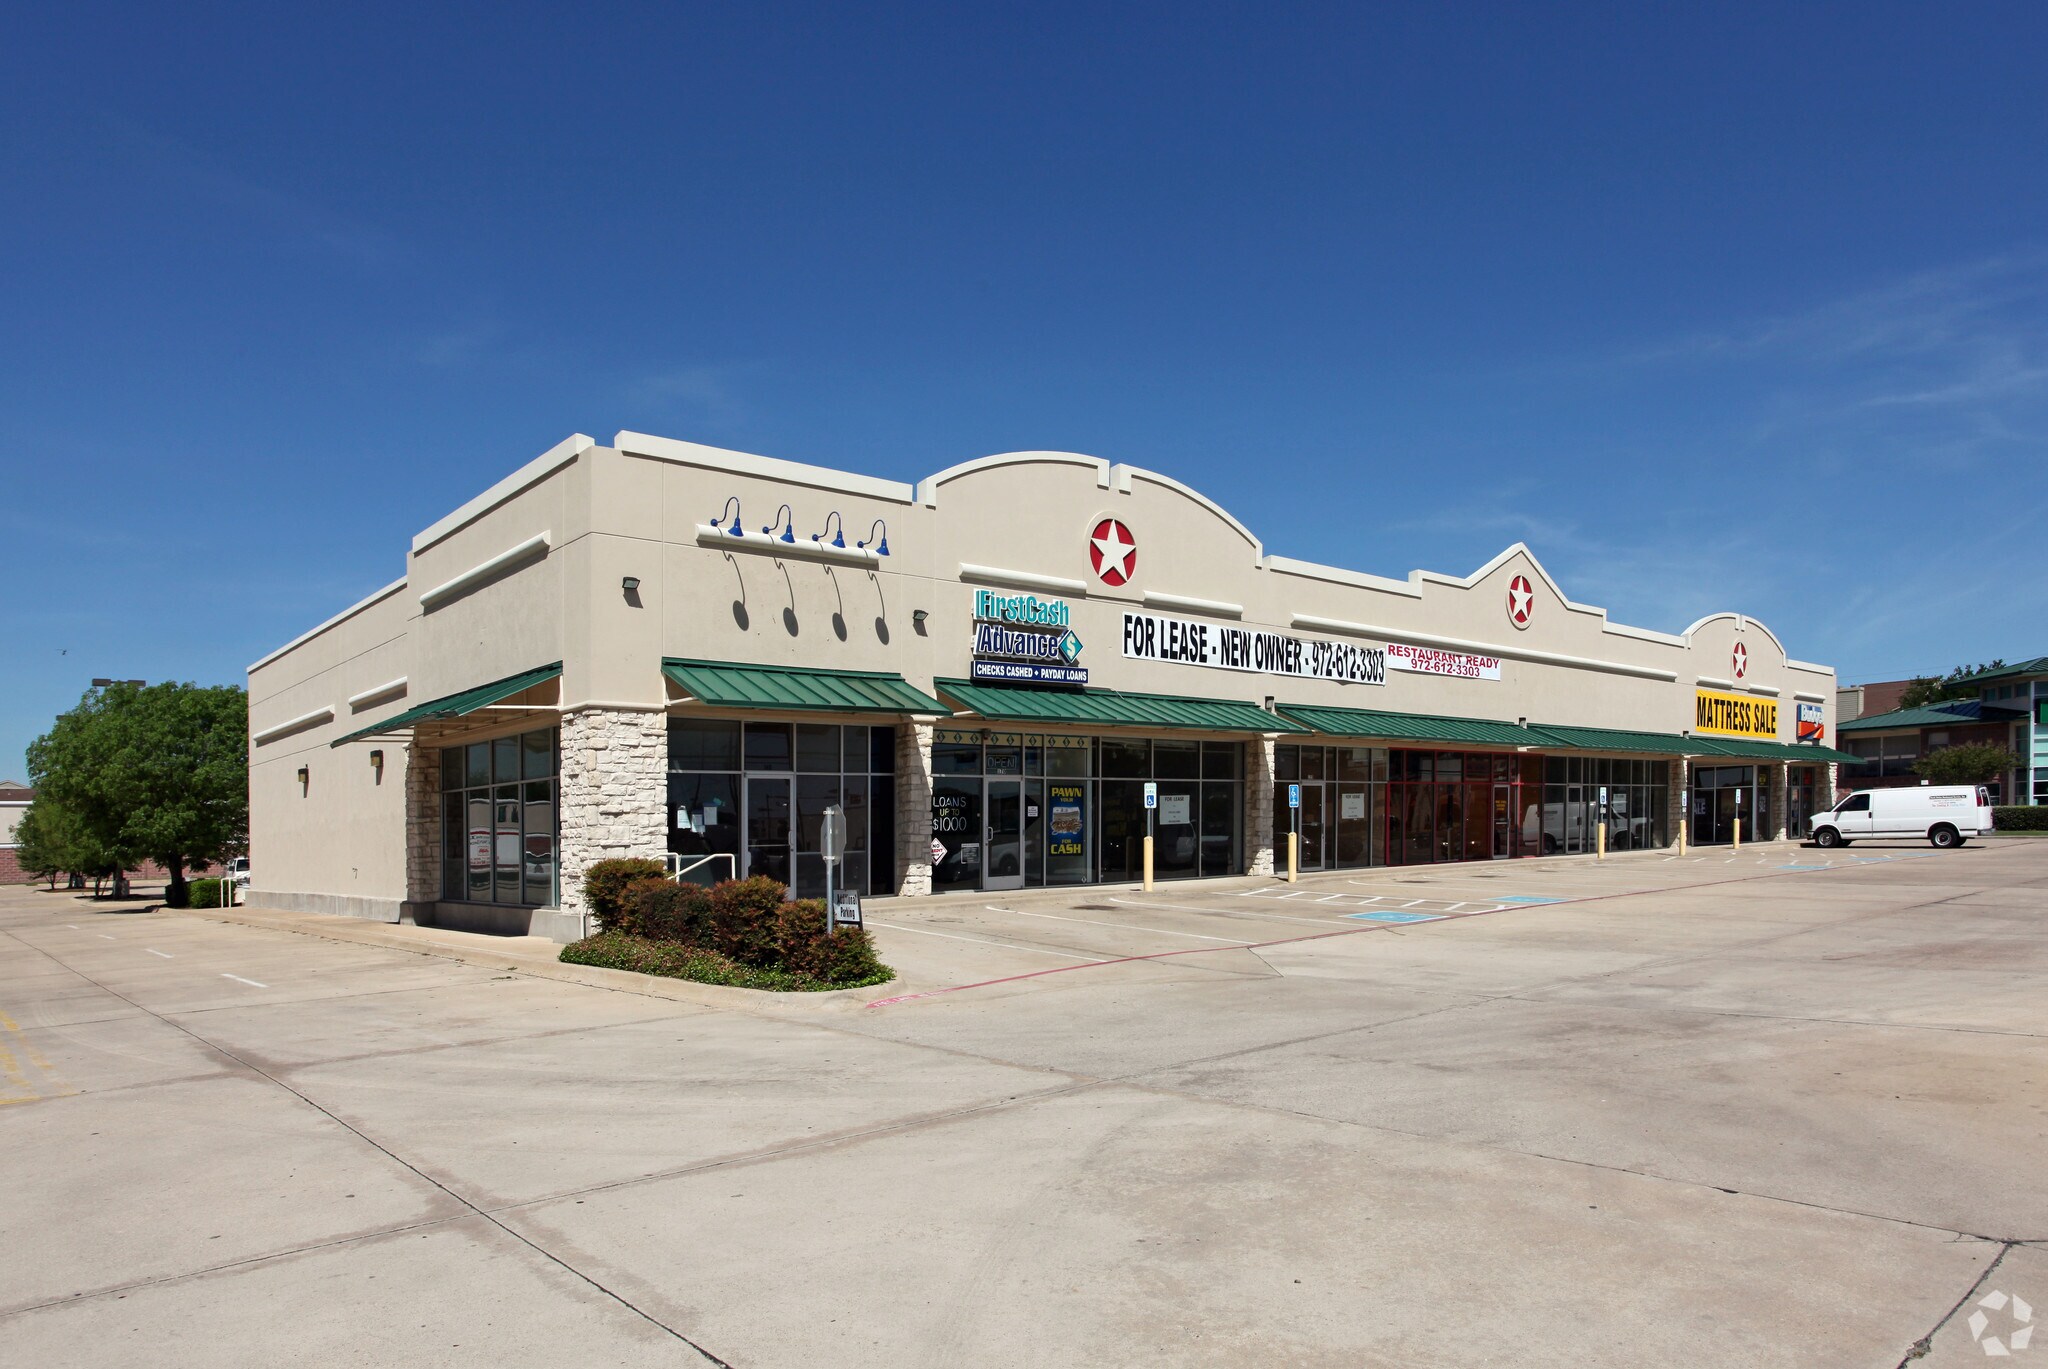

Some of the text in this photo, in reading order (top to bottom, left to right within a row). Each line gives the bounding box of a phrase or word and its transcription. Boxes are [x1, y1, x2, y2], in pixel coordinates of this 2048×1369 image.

[975, 589, 1069, 626] FirstCash
[976, 624, 1059, 658] Advance
[1123, 614, 1155, 657] FOR
[1160, 619, 1208, 663] LEASE
[1220, 628, 1251, 668] NEW
[1254, 633, 1302, 674] OWNER
[1312, 641, 1385, 683] 972-612-3303
[1388, 644, 1500, 669] RESTAURANT READY
[976, 664, 1087, 681] CHECKS CASHED PAYDAY LOANS
[1411, 658, 1481, 677] 972-612-3303
[1697, 696, 1776, 734] MATTRESS SALE
[987, 756, 1015, 768] OPEN
[1051, 787, 1082, 797] PAWN
[932, 796, 967, 808] LOANS
[940, 808, 961, 817] UP TO
[932, 816, 967, 831] $1000
[1050, 844, 1082, 854] CASH
[840, 906, 856, 920] Parking
